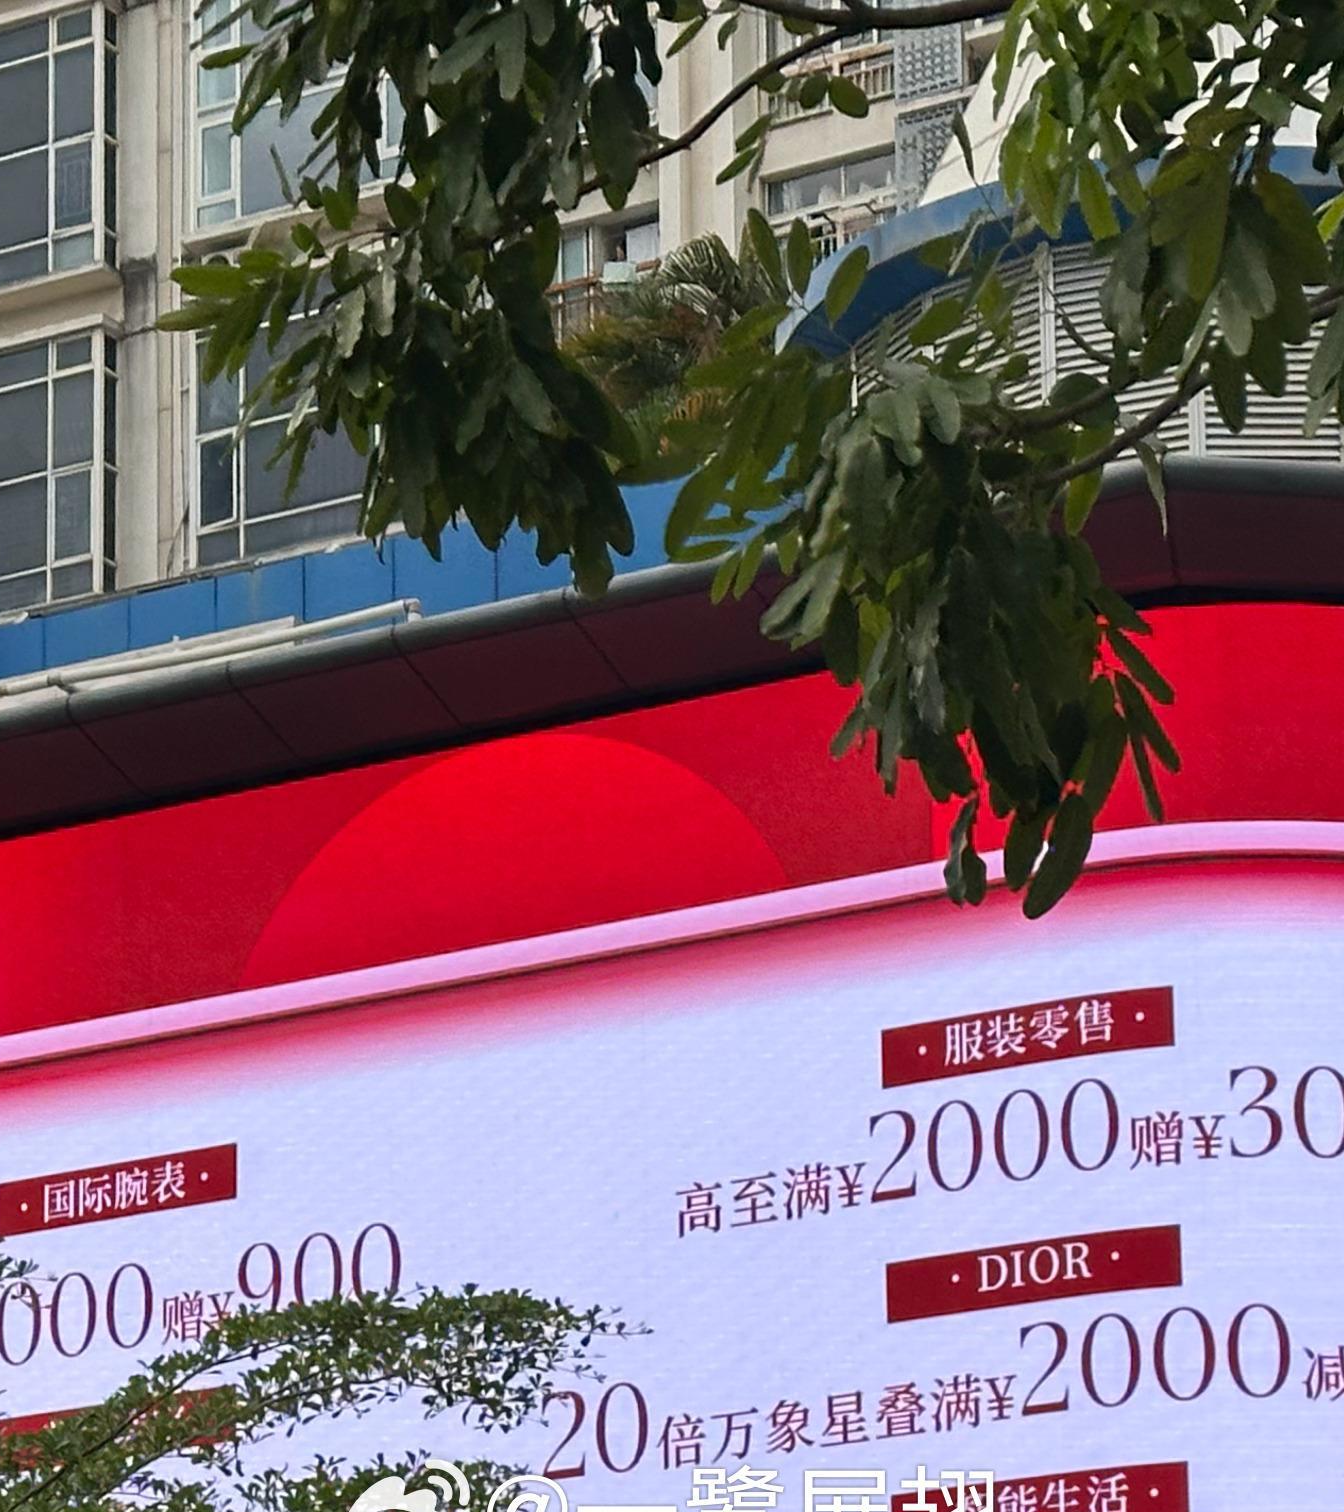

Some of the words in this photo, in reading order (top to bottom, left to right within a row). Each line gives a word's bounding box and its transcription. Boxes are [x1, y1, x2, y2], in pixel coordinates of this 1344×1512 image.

[943, 999, 1115, 1066] 服装零售
[41, 1161, 187, 1223] 国际腕表
[976, 1241, 1093, 1293] DIOR
